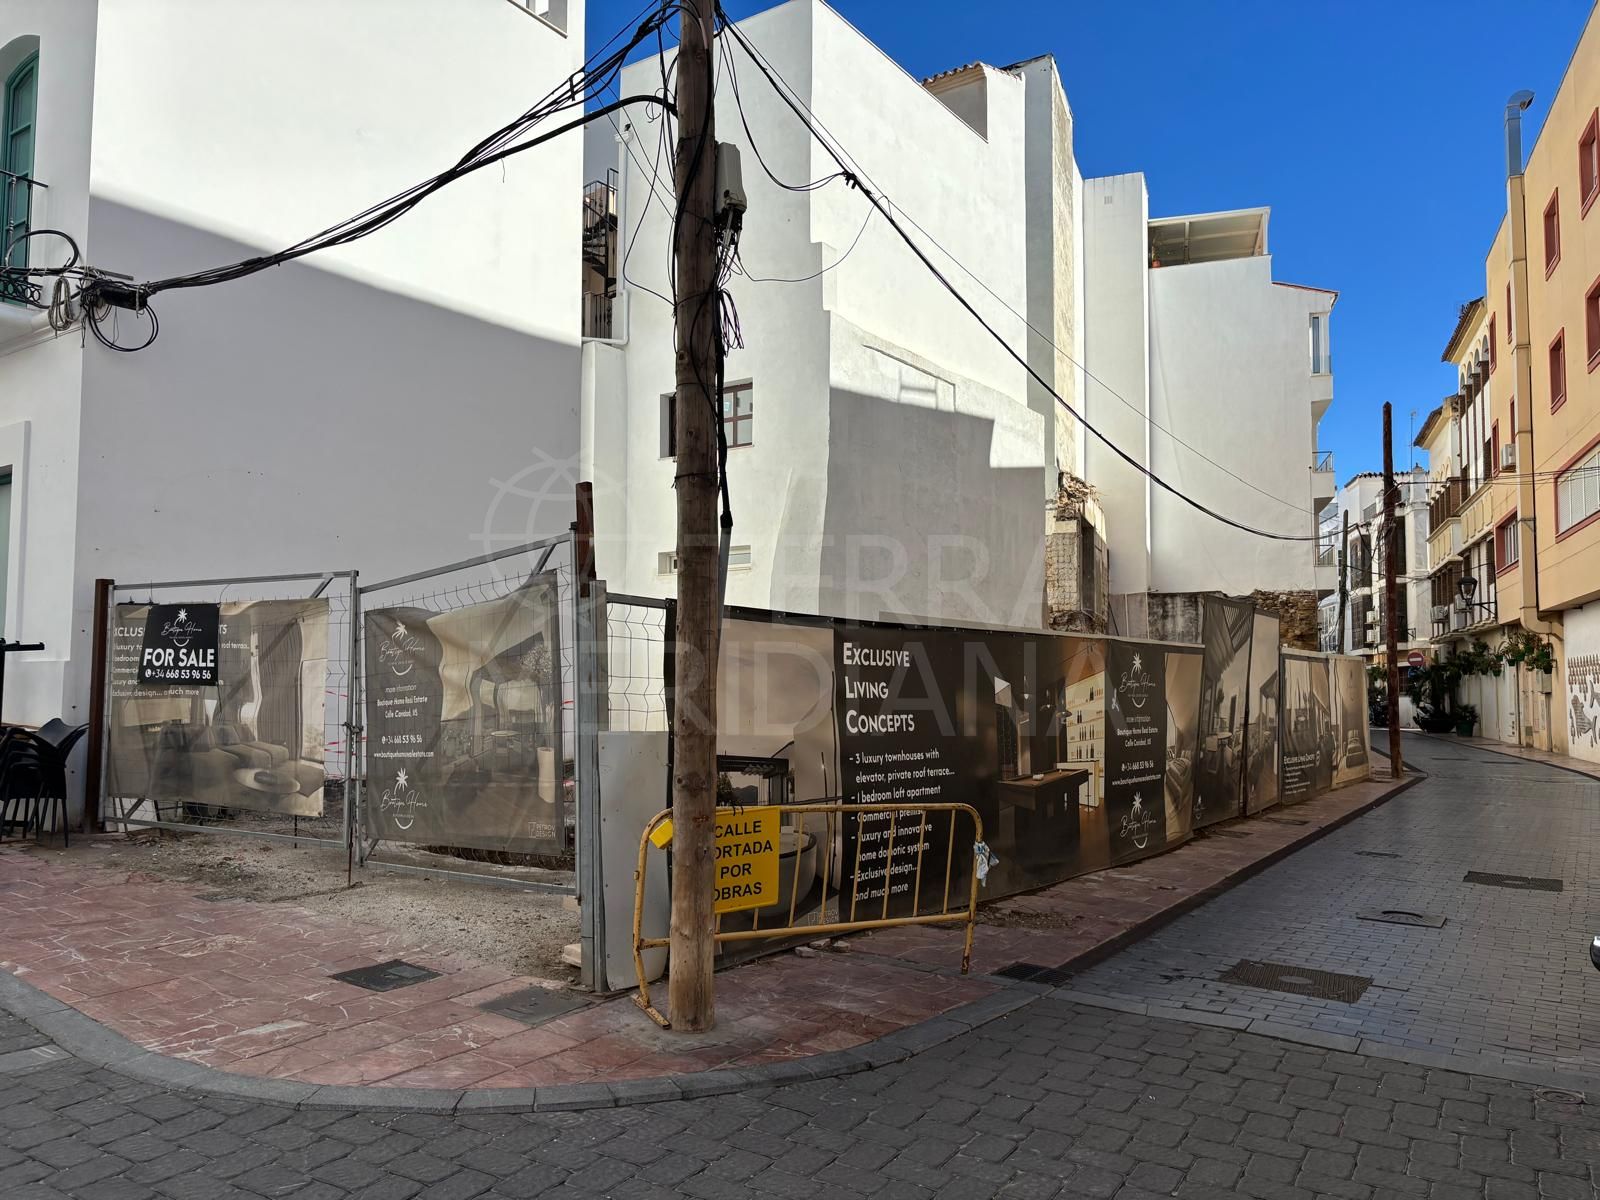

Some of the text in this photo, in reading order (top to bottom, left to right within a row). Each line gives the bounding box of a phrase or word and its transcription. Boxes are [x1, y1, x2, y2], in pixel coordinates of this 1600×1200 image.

[143, 648, 215, 667] FOR SALE
[843, 642, 910, 667] EXCLUSIVE
[152, 669, 211, 679] +34 668 53 96 56
[844, 676, 889, 699] LIVING
[846, 709, 915, 734] CONCEPTS
[402, 734, 409, 743] 53
[855, 753, 860, 764] 3
[861, 751, 884, 766] luxury
[885, 749, 924, 762] townhouses
[925, 747, 940, 759] with
[855, 771, 887, 784] elevator,
[887, 769, 911, 783] private
[912, 766, 926, 778] roof
[861, 789, 892, 803] bedroom
[893, 786, 905, 799] loft
[906, 785, 941, 800] apartment
[857, 810, 898, 822] Commercil
[716, 820, 762, 838] CALLE
[716, 840, 773, 859] ORTADA
[721, 863, 752, 879] POR
[891, 883, 908, 894] more
